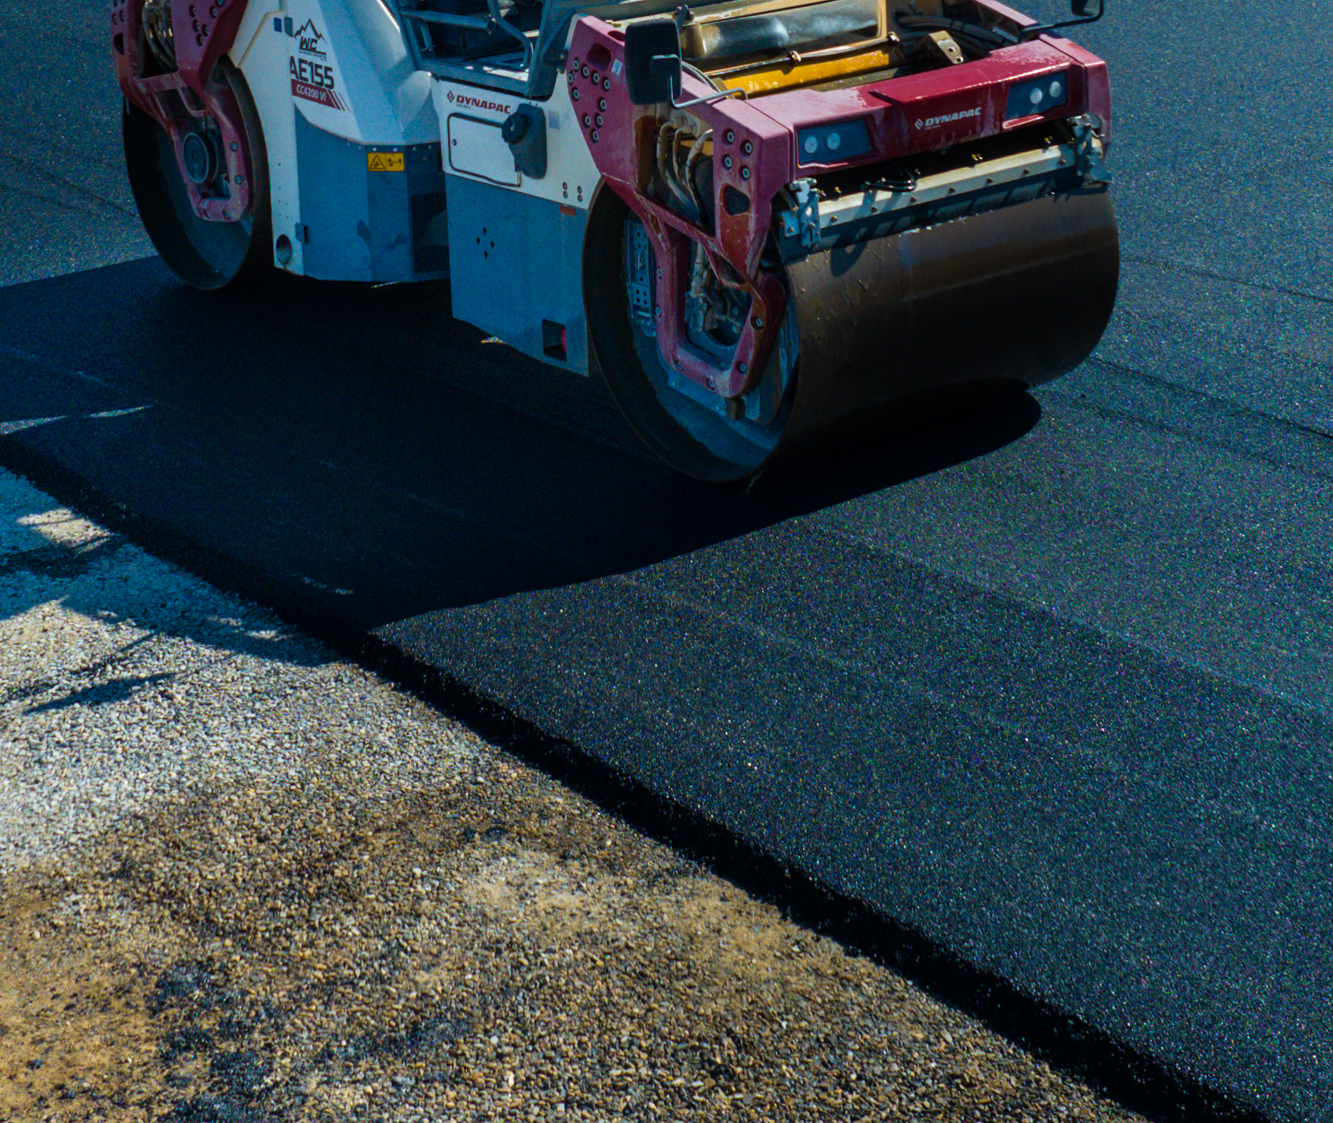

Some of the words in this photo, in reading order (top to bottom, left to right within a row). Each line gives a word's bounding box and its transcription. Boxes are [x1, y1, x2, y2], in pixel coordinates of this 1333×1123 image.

[289, 55, 335, 90] AE155
[455, 94, 512, 115] DYNAPAC
[924, 106, 983, 127] DYNAPAC
